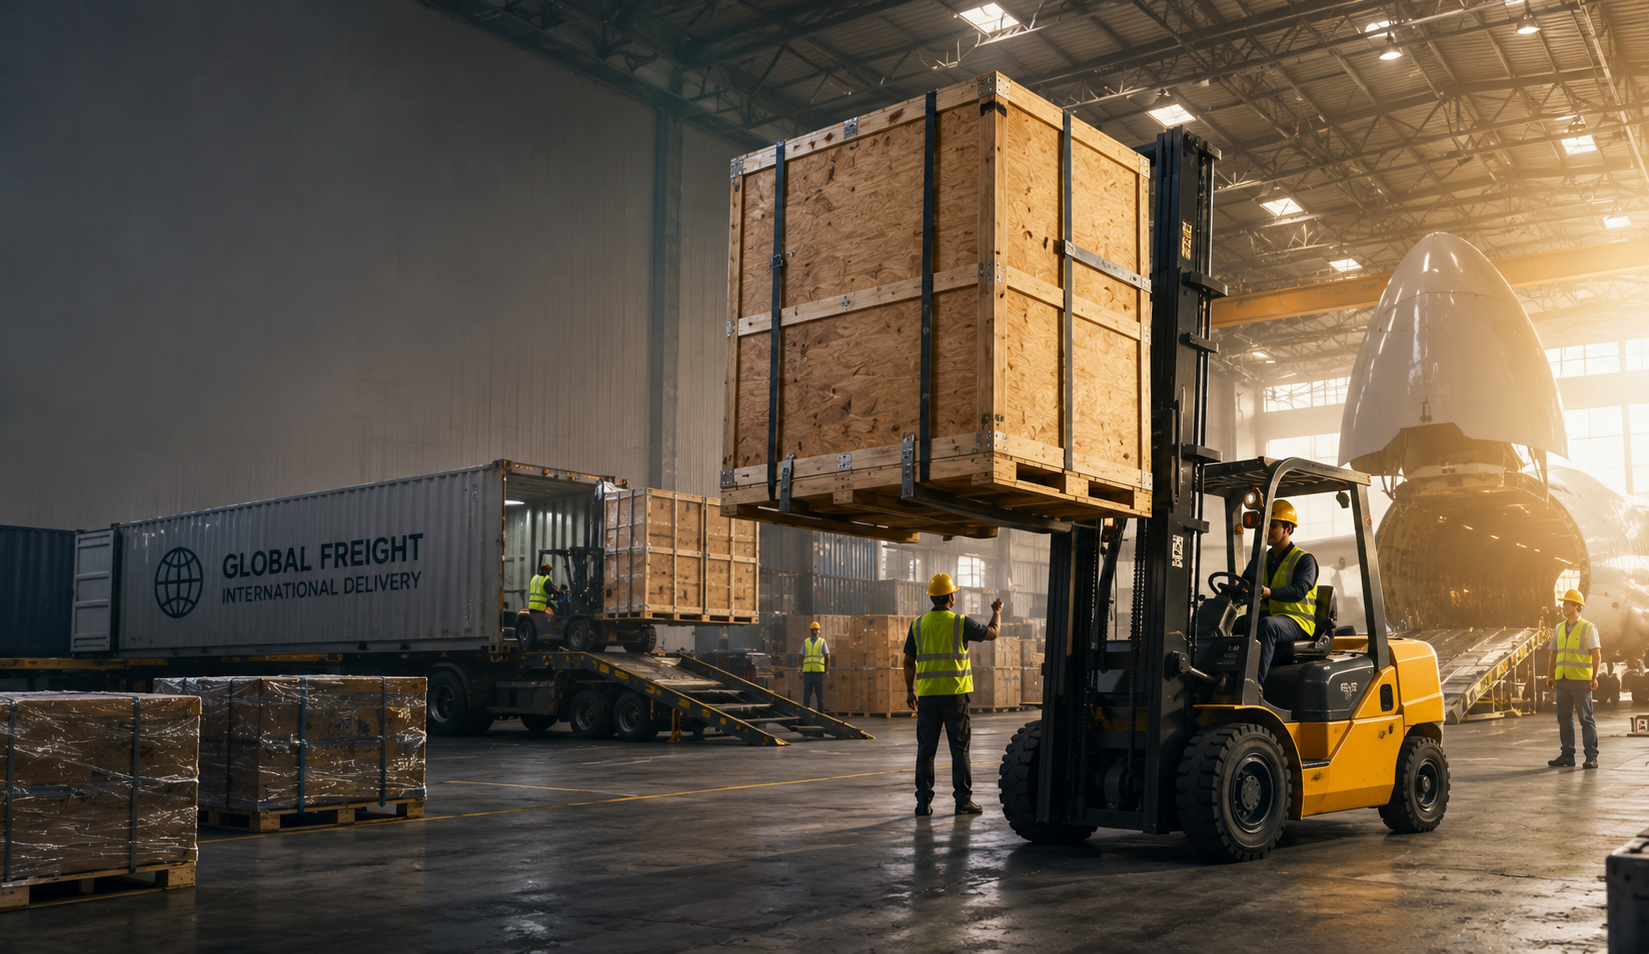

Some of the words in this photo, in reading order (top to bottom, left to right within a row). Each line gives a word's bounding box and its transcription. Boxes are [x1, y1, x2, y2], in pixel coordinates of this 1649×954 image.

[222, 546, 312, 579] GLOBAL
[320, 533, 423, 569] FREIGHT
[222, 578, 338, 604] INTERNATIONAL
[343, 571, 422, 595] DELIVERY
